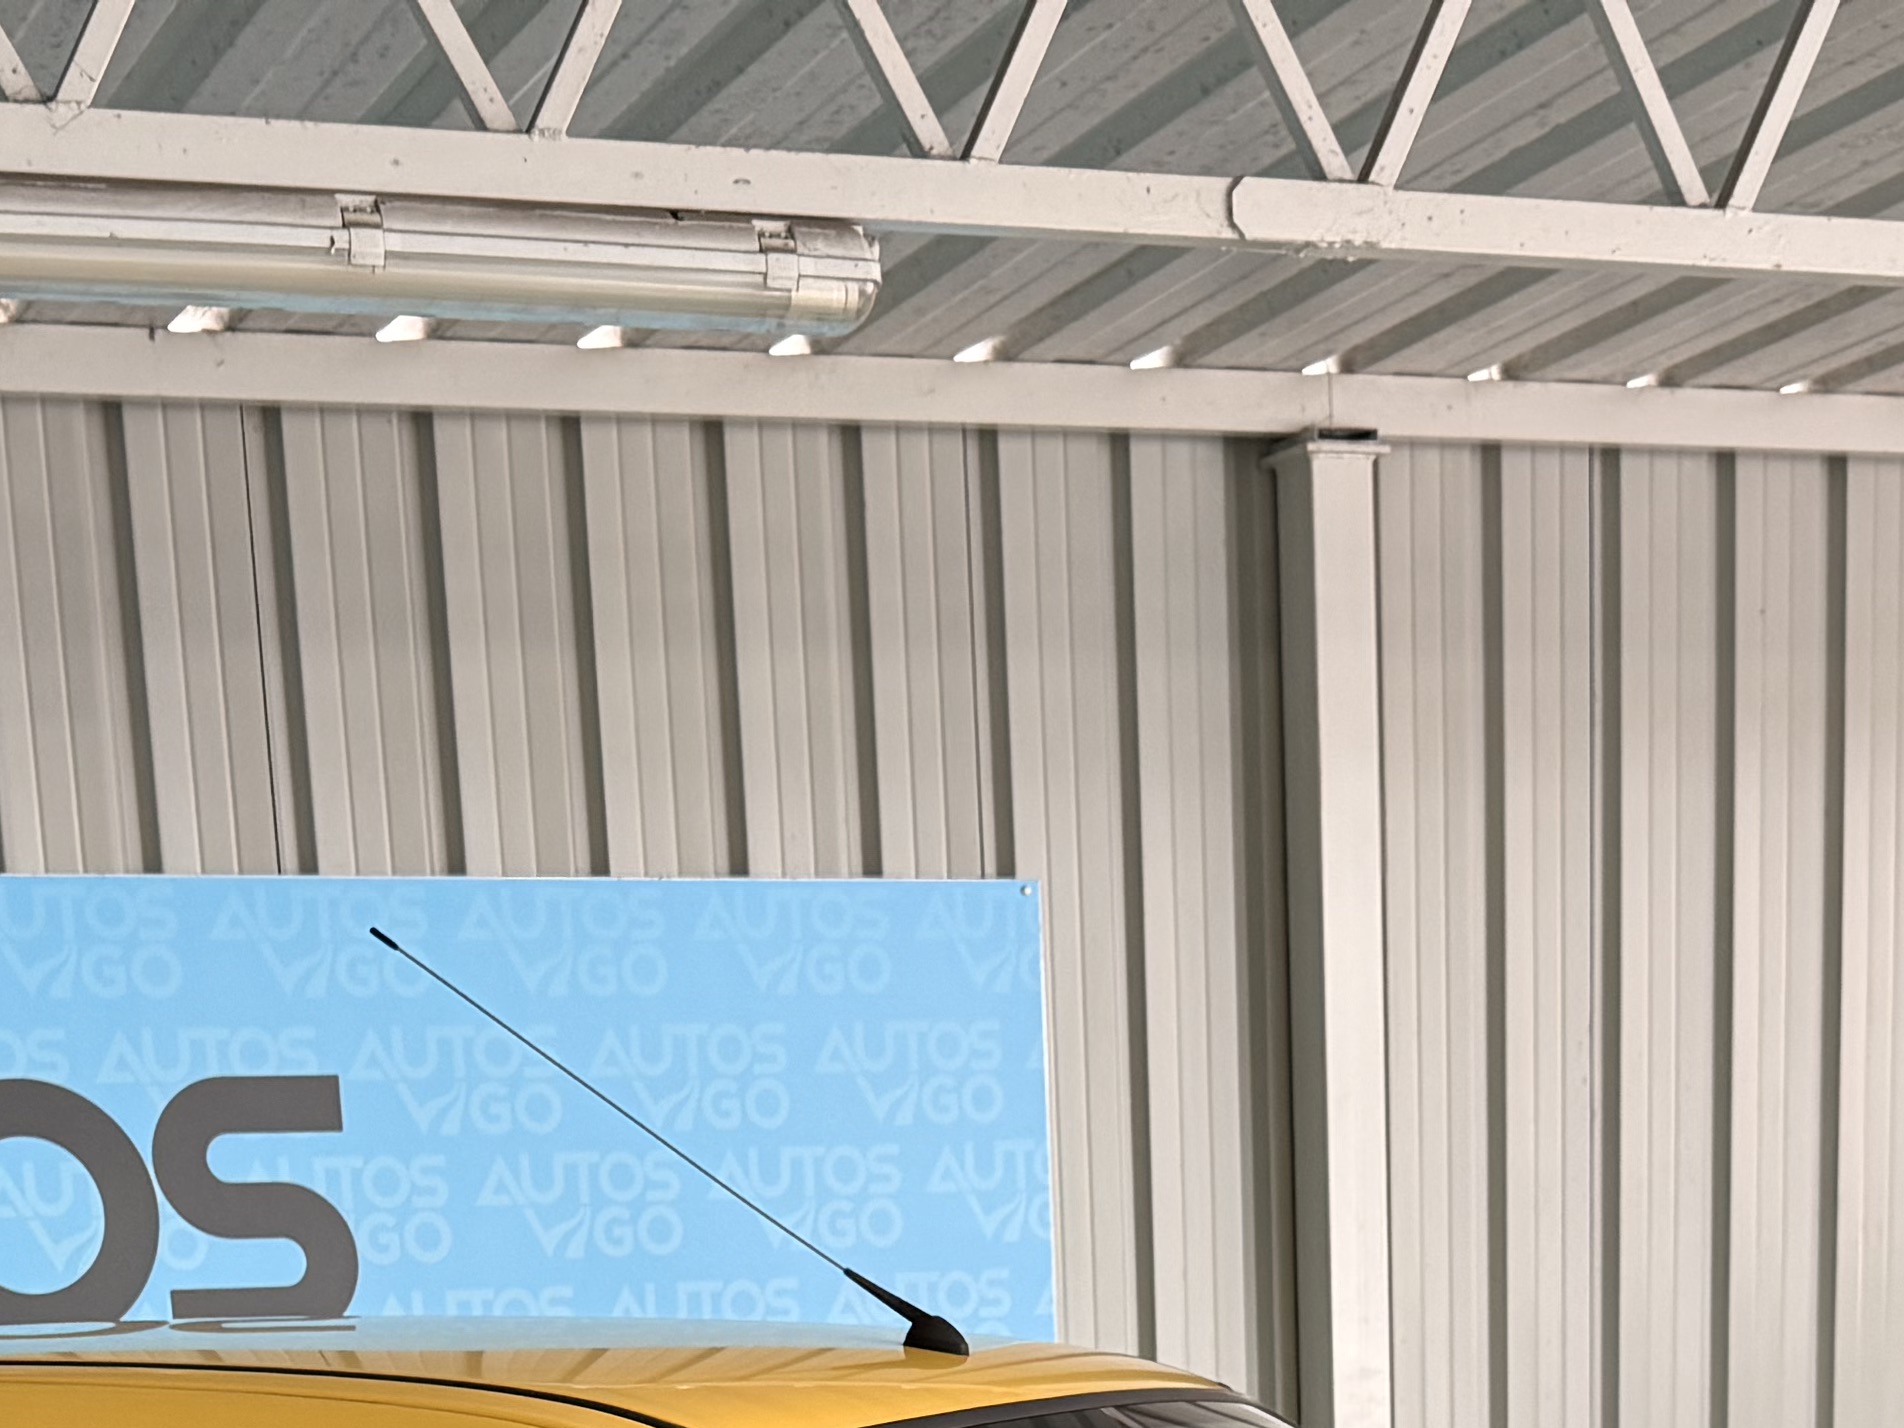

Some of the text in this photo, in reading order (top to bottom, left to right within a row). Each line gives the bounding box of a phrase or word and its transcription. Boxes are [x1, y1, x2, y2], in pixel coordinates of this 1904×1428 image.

[209, 883, 429, 940] AUTOS
[458, 884, 667, 939] AUTOS
[694, 885, 893, 939] AUTOS
[919, 886, 1040, 939] AUT
[0, 940, 183, 998] VIGO
[258, 940, 432, 996] VIGO
[504, 939, 670, 994] VIGO
[738, 939, 895, 992] VIGO
[961, 939, 1040, 990] VI
[95, 1025, 318, 1083] AUTOS
[347, 1022, 560, 1079] AUTOS
[588, 1020, 790, 1075] AUTOS
[817, 1018, 1009, 1072] AUTOS
[394, 1077, 563, 1132] VIGO
[632, 1073, 792, 1127] VIGO
[859, 1070, 1011, 1122] VIGO
[476, 1144, 682, 1202] AUTOS
[709, 1139, 905, 1195] AUTOS
[931, 1136, 1048, 1189] AUT
[339, 1205, 451, 1261] GO
[521, 1198, 684, 1253] VIGO
[752, 1192, 907, 1245] VIGO
[972, 1188, 1050, 1238] VI
